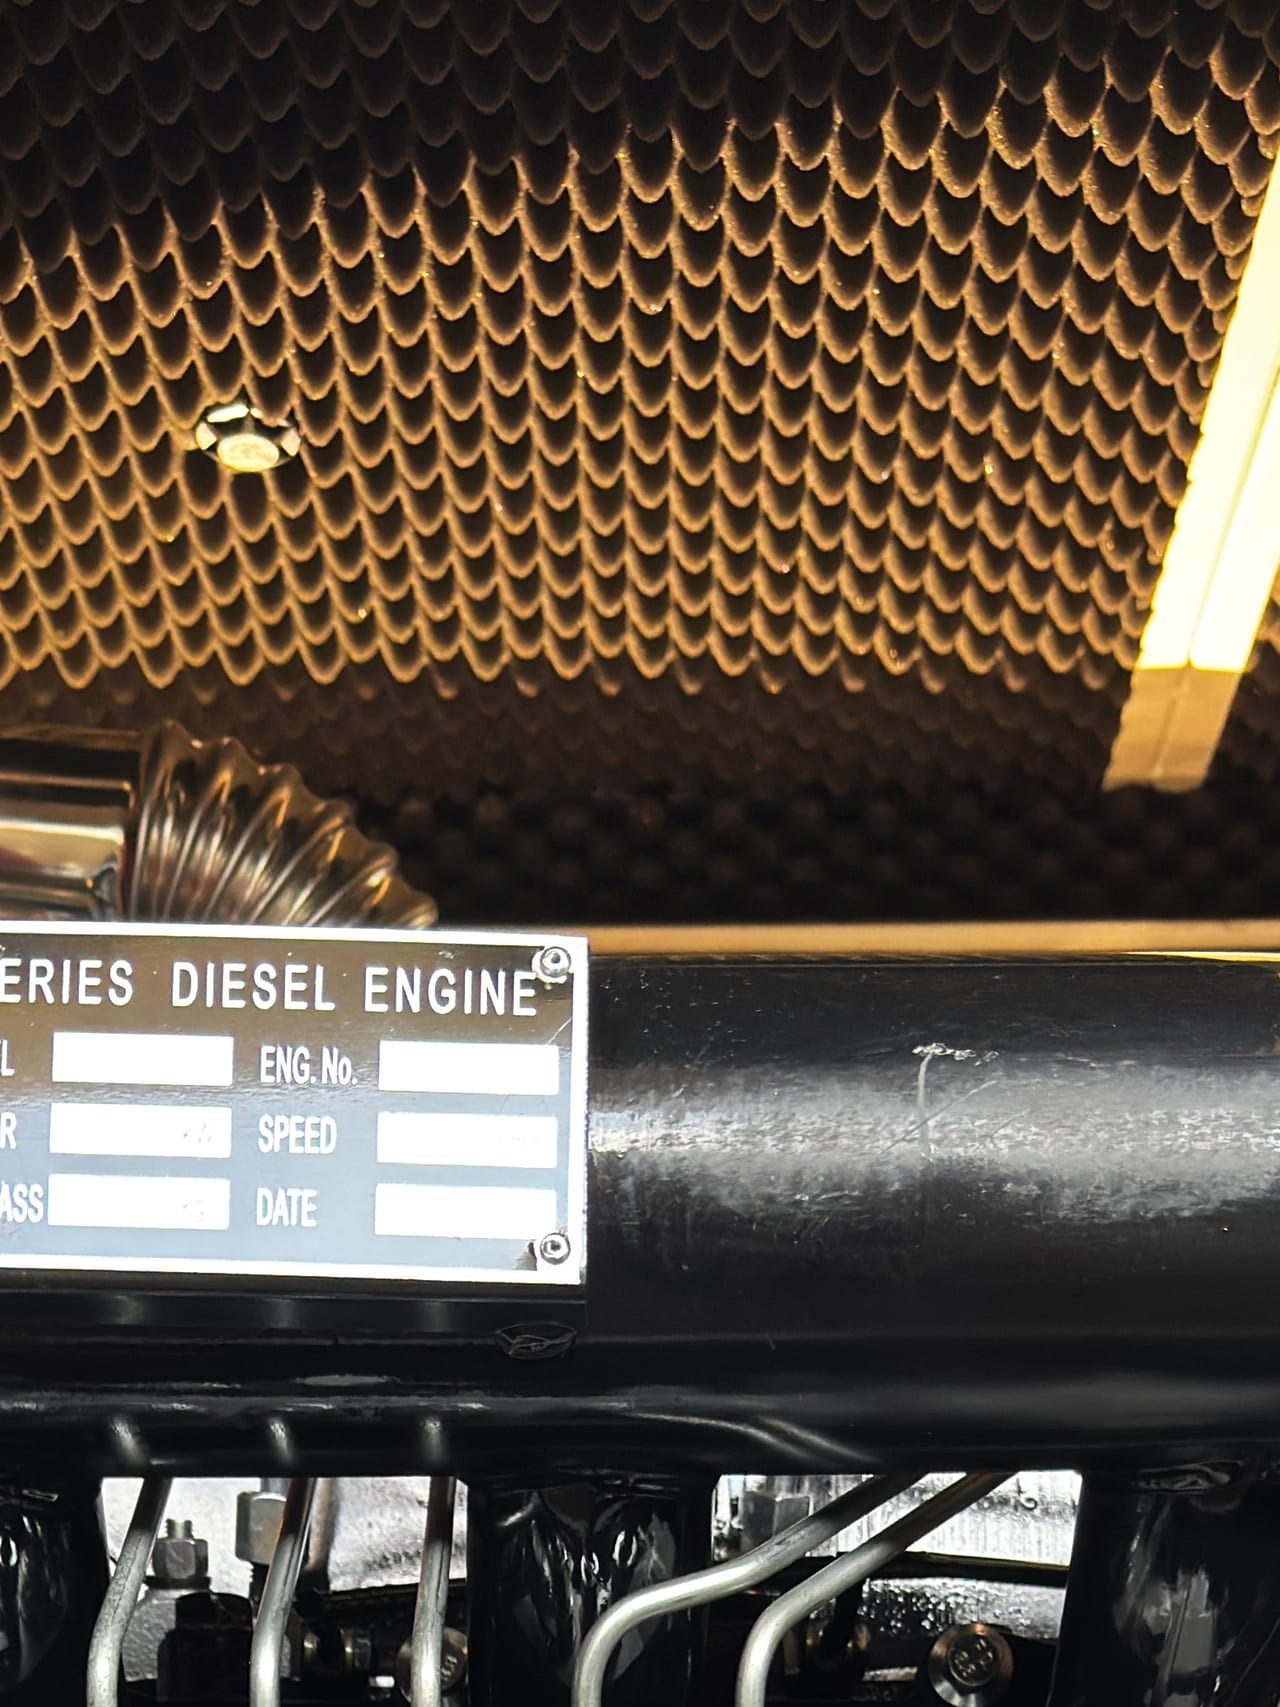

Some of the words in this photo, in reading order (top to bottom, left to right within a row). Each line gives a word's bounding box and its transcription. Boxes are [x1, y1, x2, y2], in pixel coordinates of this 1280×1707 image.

[171, 962, 336, 1012] DIESEL
[365, 966, 538, 1016] ENGINE
[258, 1115, 337, 1155] SPEED
[256, 1188, 318, 1228] DATE
